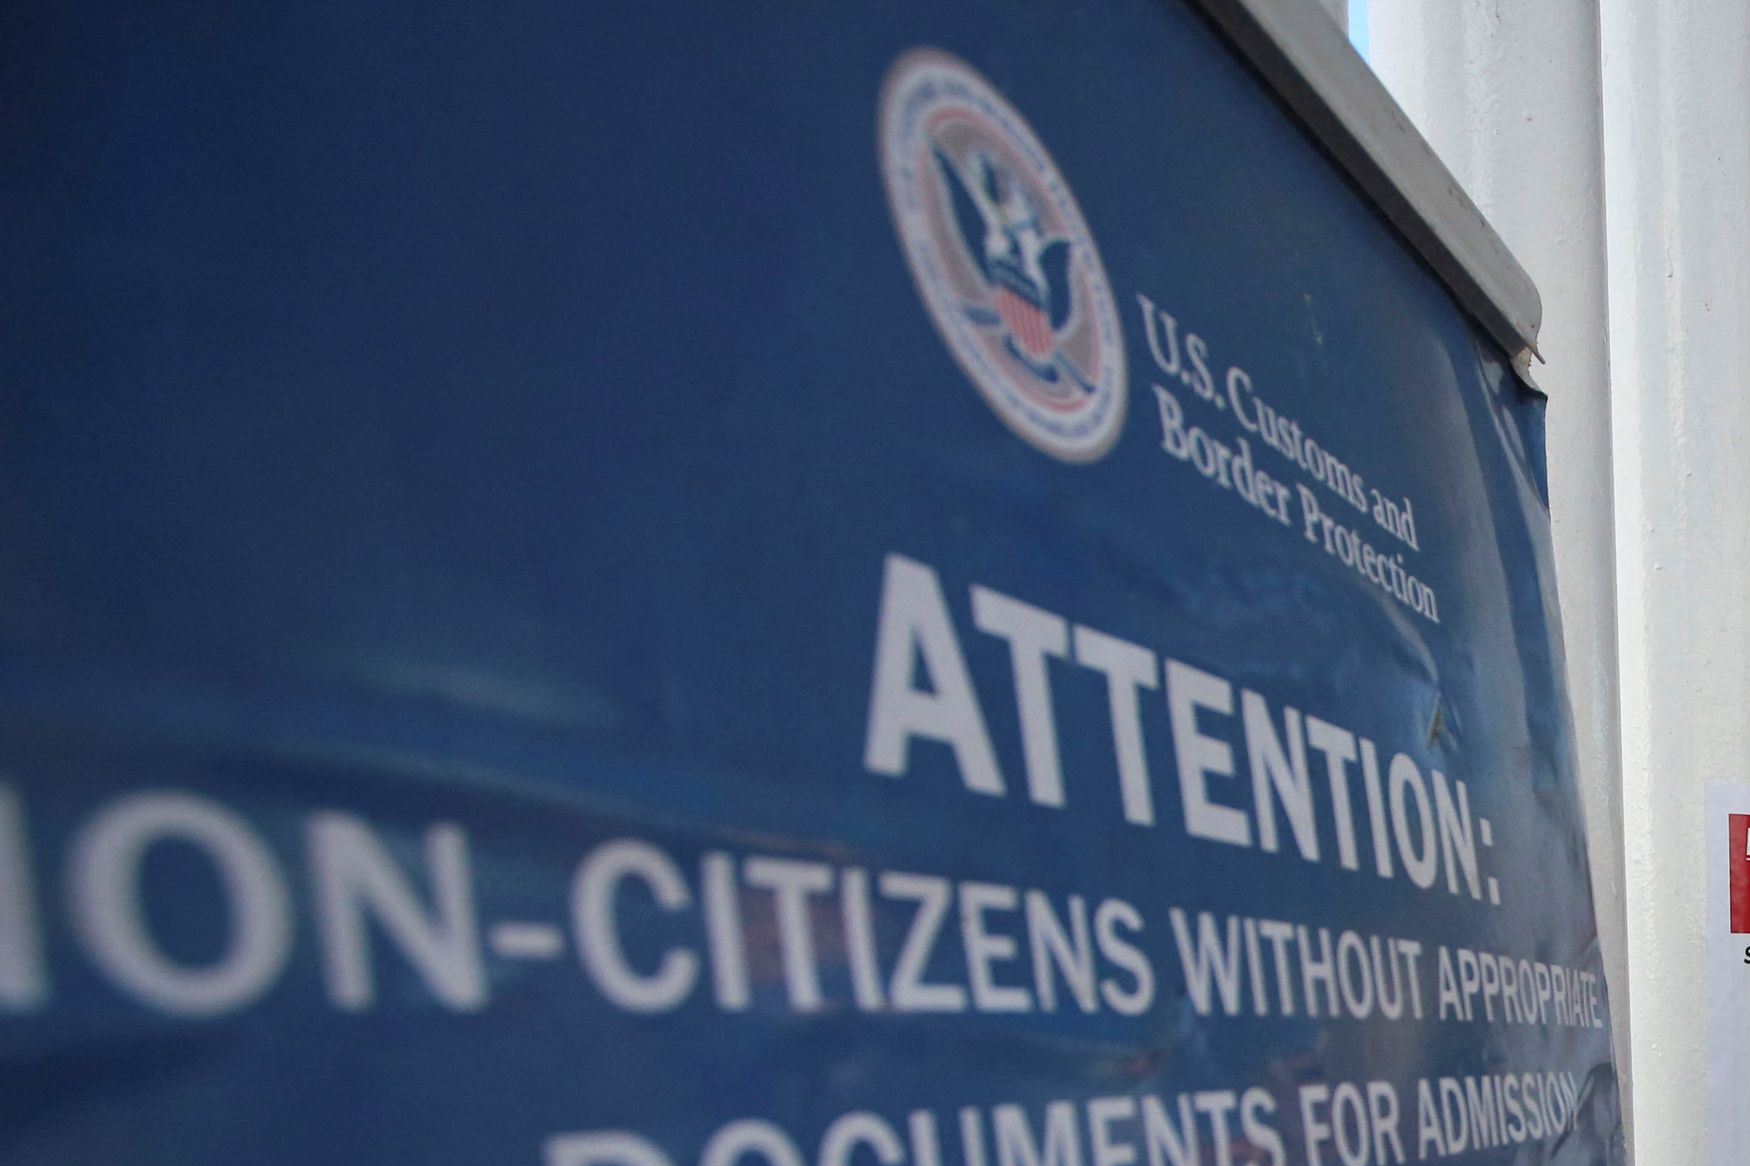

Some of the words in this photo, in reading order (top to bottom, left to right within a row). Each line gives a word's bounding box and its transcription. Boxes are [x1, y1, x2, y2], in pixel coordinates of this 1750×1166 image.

[1137, 294, 1224, 410] U.S.
[1226, 366, 1367, 512] Customs
[1371, 484, 1421, 551] and
[1152, 384, 1292, 527] Border
[1297, 482, 1440, 624] Protection
[863, 552, 1501, 906] ATTENTION:
[1169, 906, 1423, 1021] WITHOUT
[1438, 944, 1603, 1029] APPROPRIATE
[1417, 1069, 1580, 1161] ADMISSION
